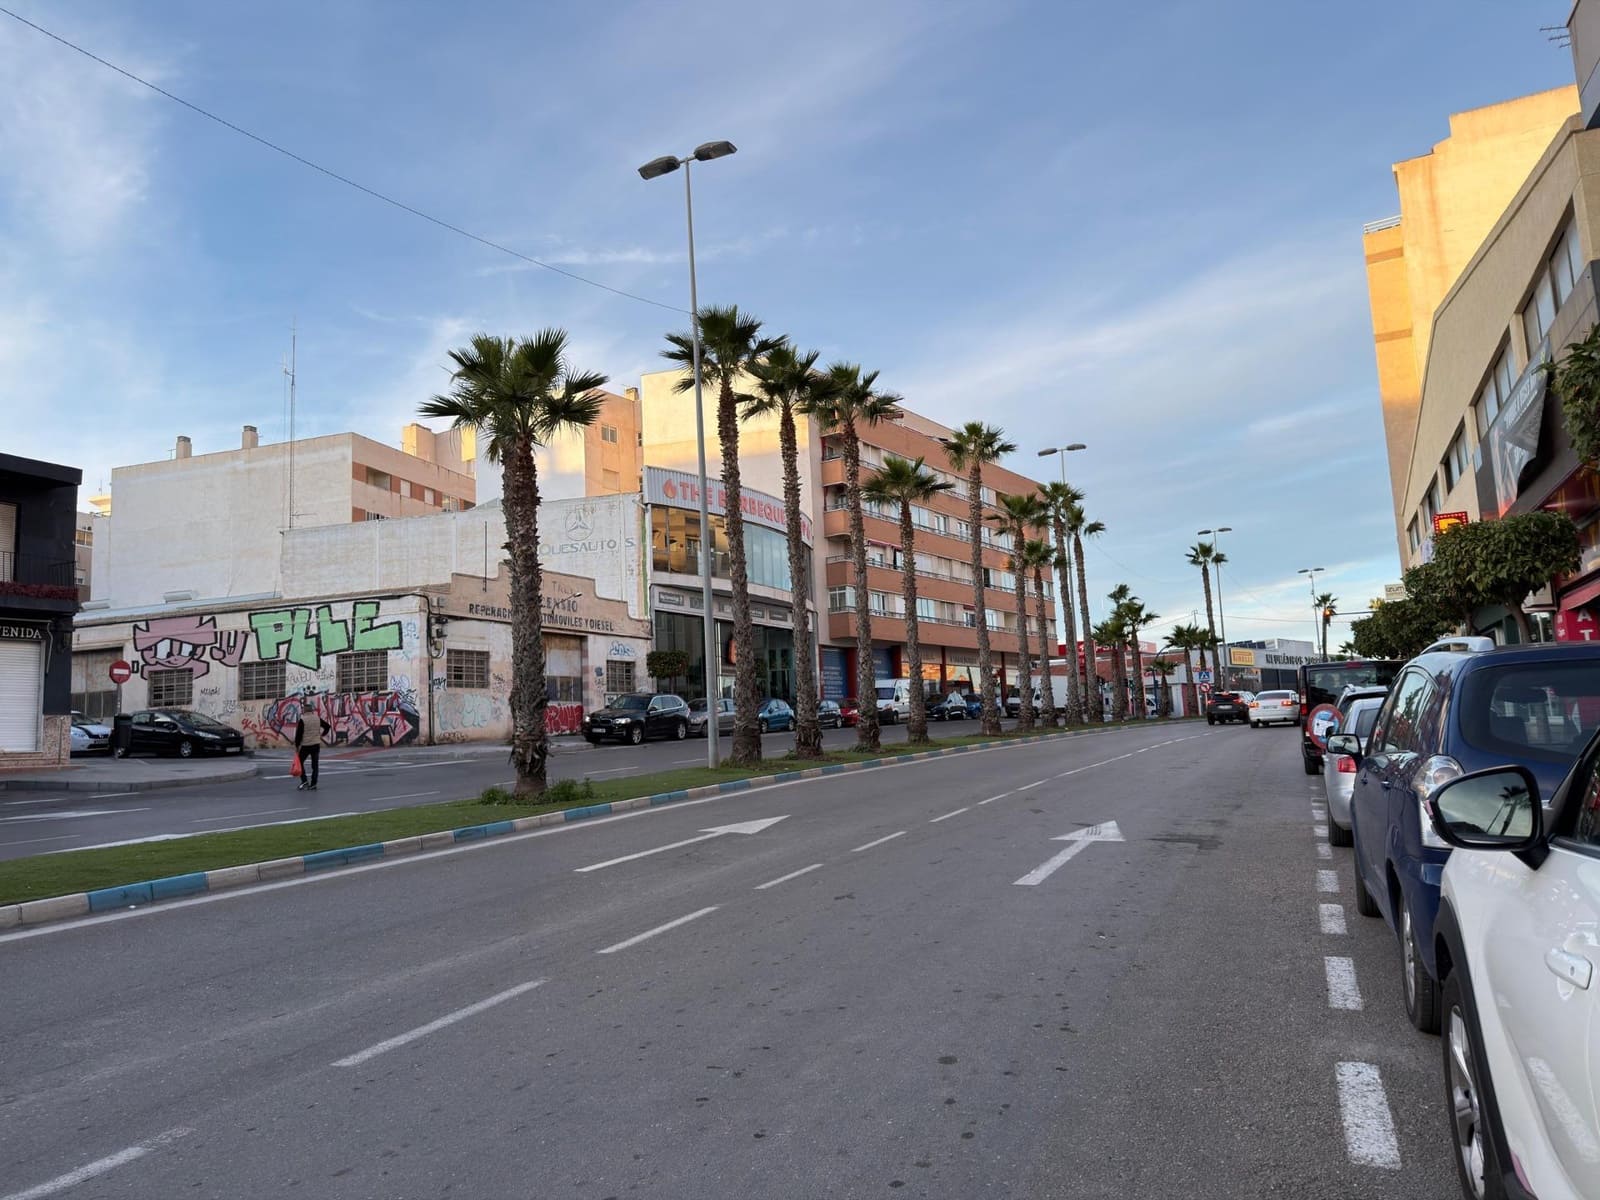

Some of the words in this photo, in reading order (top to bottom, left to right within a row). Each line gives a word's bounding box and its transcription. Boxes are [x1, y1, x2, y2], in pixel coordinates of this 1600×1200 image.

[679, 481, 713, 506] THE
[717, 490, 786, 526] BRBEQUE
[590, 619, 614, 632] DIESEL
